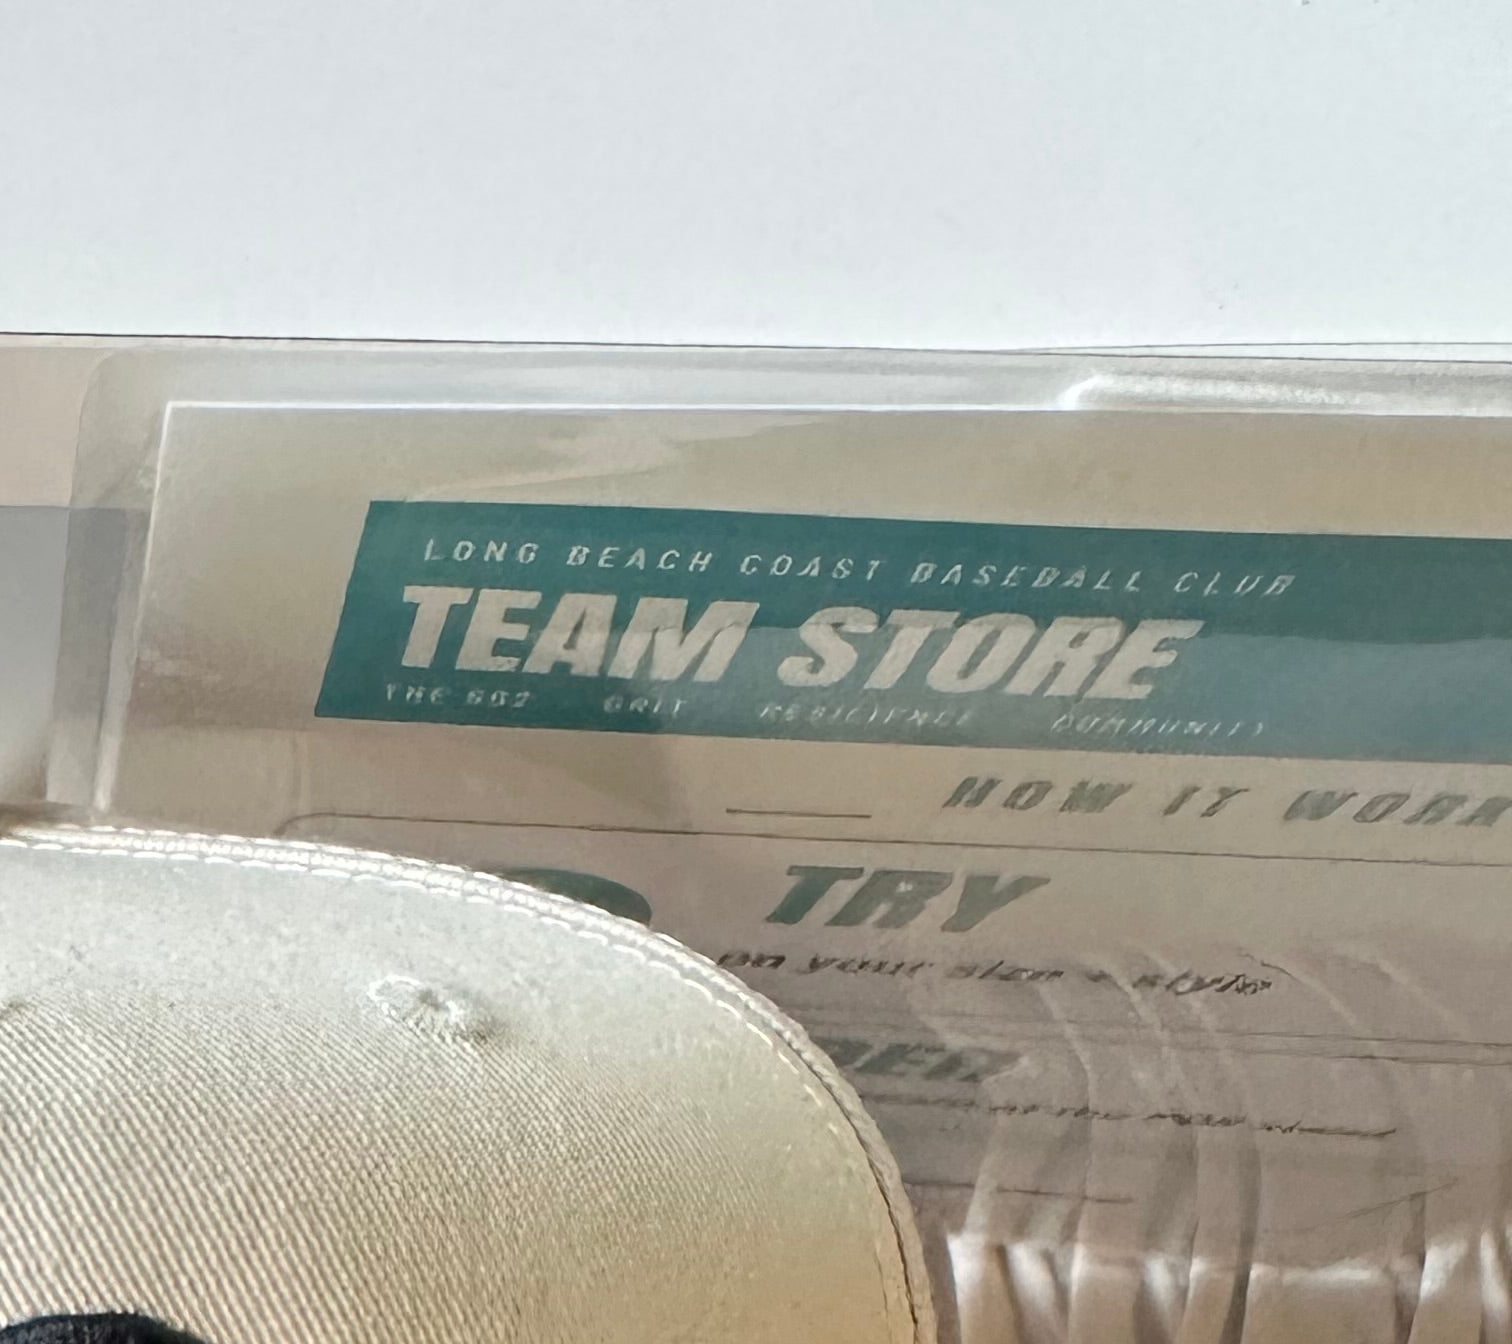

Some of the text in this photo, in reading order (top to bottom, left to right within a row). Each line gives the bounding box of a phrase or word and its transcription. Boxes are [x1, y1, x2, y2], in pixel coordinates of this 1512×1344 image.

[424, 538, 1296, 597] LONG BEACH COAST BASEBALL CLUB
[401, 585, 1204, 700] TEAM STORE
[943, 776, 1132, 812] HOW
[1163, 786, 1250, 817] IT
[766, 864, 1050, 932] TRY
